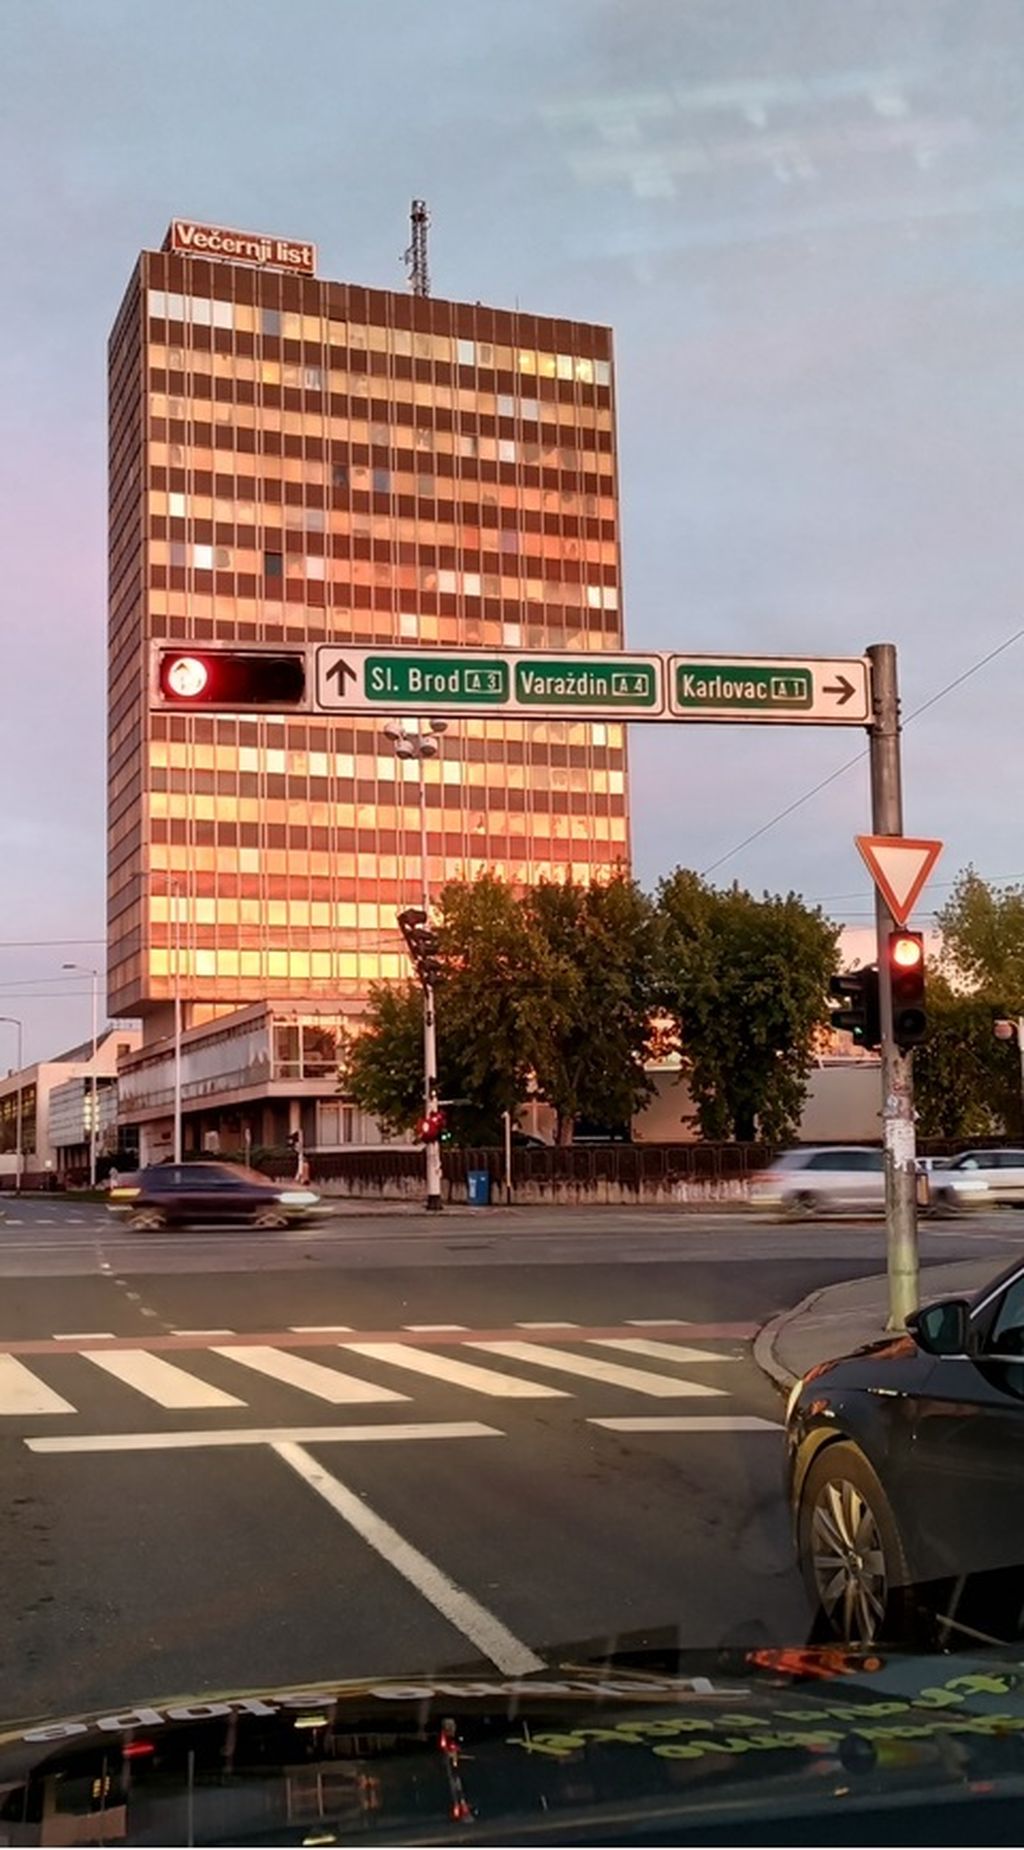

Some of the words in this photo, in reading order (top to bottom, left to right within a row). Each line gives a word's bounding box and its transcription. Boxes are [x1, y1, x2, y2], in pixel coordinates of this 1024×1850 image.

[177, 224, 271, 266] Večernji
[277, 243, 312, 267] list
[371, 666, 399, 691] Sl.
[408, 668, 460, 693] Brod
[520, 670, 607, 696] Varaždin
[683, 675, 768, 699] Karlovac
